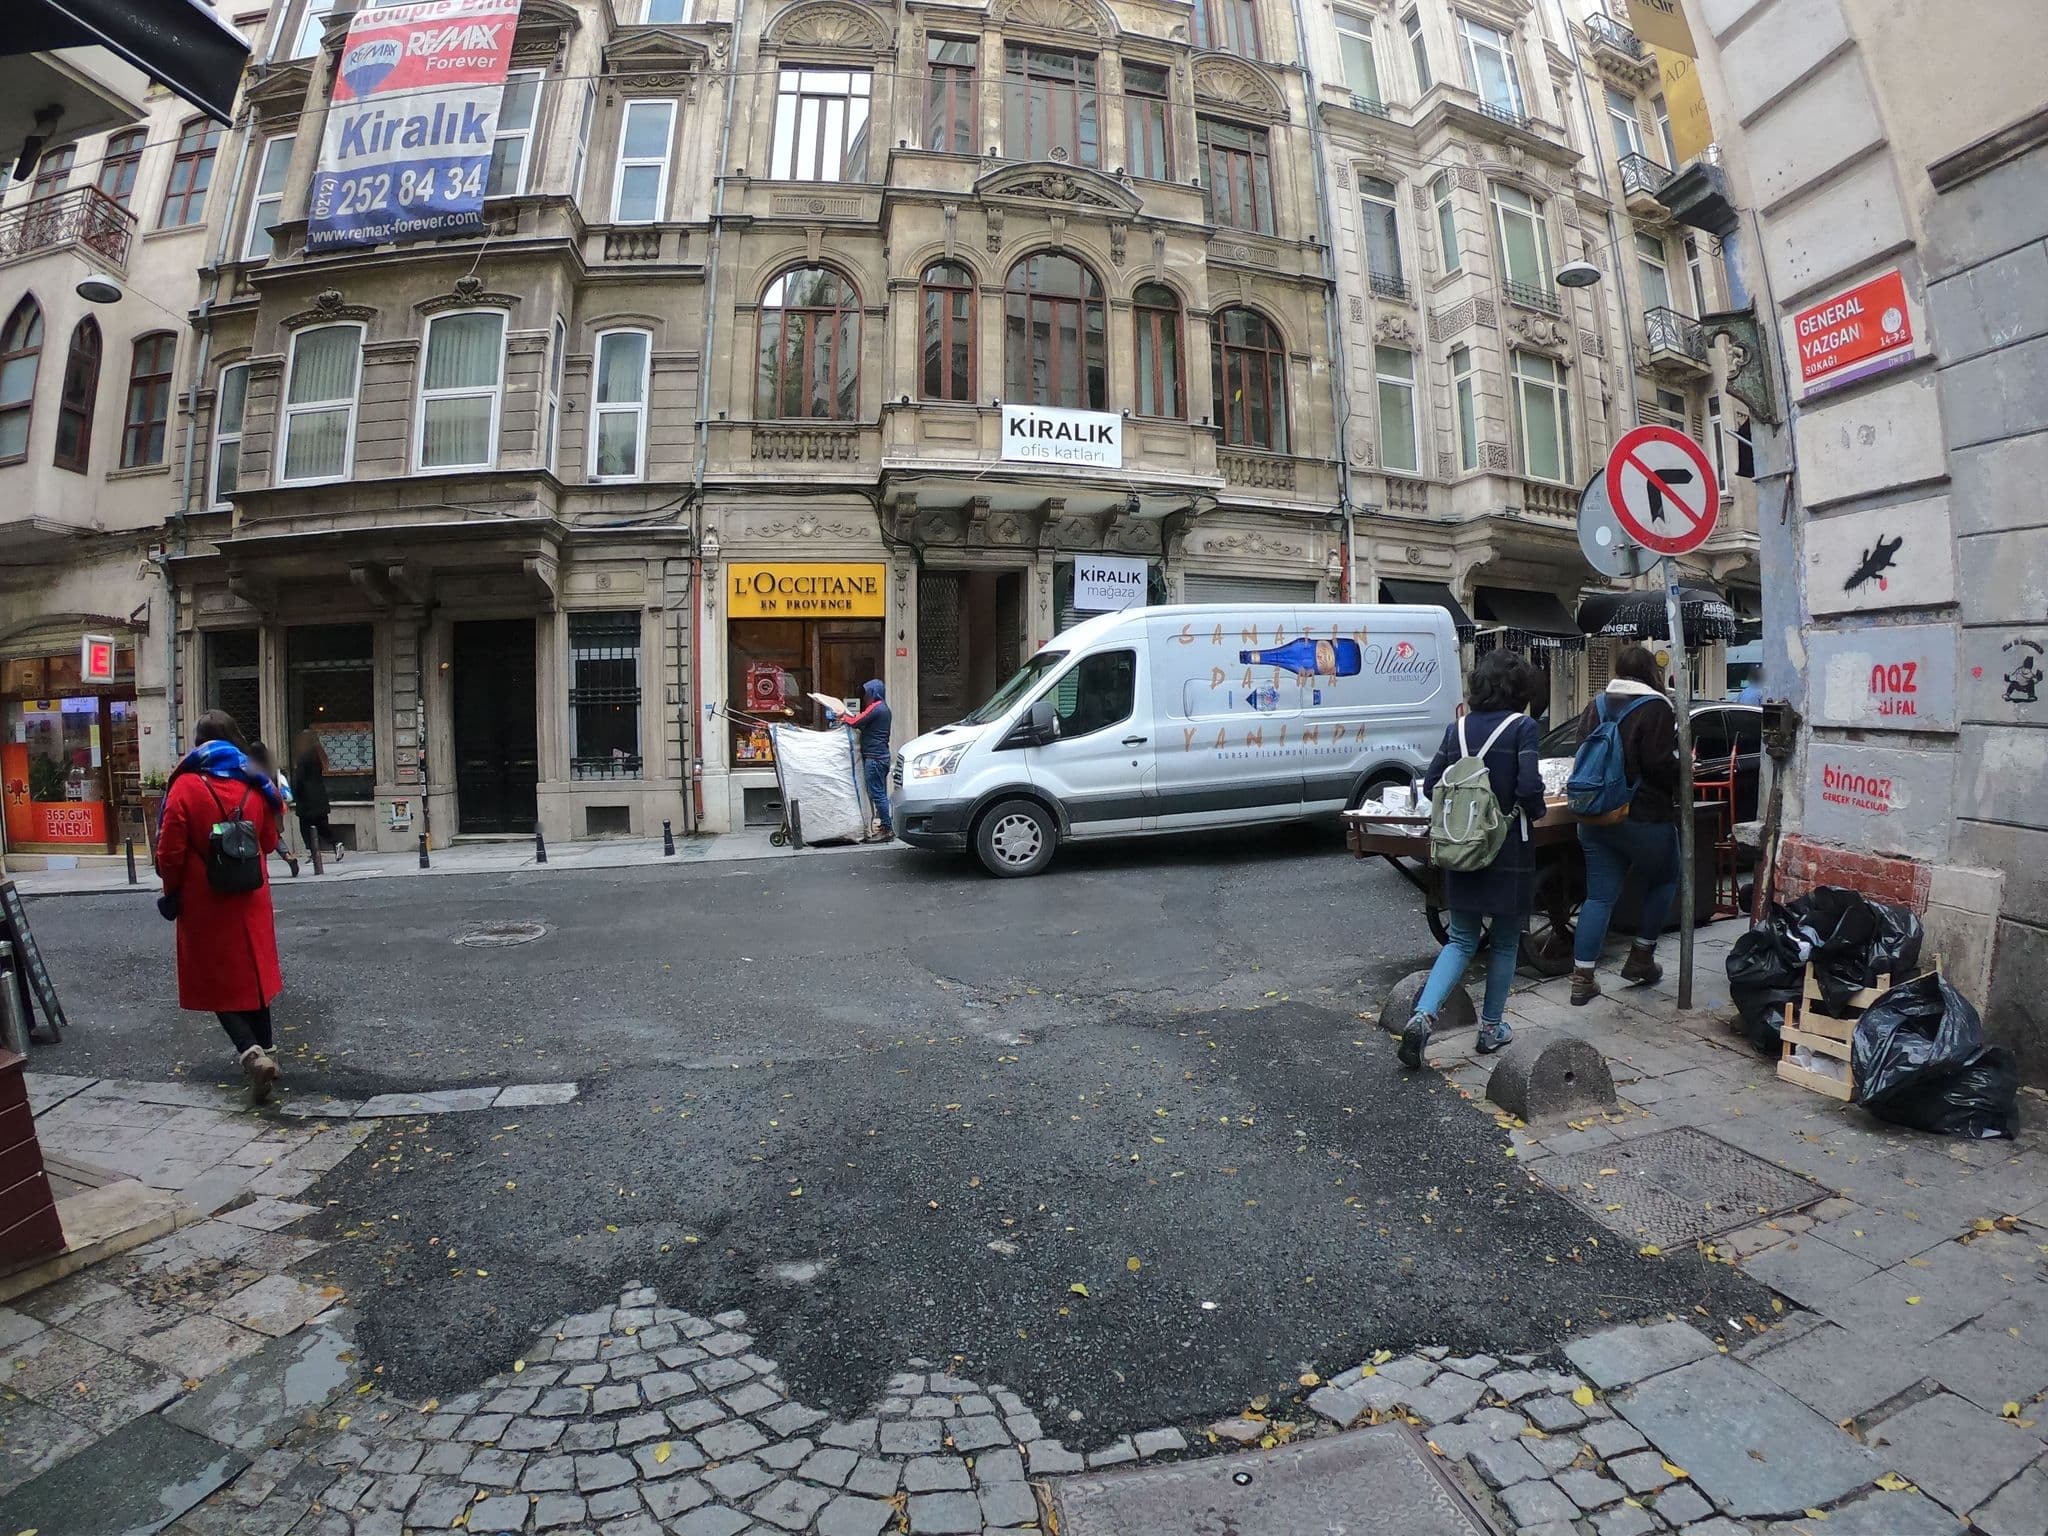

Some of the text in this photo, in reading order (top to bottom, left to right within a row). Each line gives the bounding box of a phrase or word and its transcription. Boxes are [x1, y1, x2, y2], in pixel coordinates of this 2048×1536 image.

[426, 56, 496, 71] Forever
[338, 102, 491, 160] Kiralık
[315, 164, 481, 220] (0212) 252 84 34
[313, 211, 478, 242] www.remax-forever.com
[1800, 297, 1864, 336] GENERAL
[1803, 323, 1860, 358] YAZGAN
[1805, 355, 1838, 375] SOKAĞI
[1010, 412, 1113, 444] KİRALIK
[1021, 445, 1104, 462] ofis katları
[735, 572, 877, 594] L'OCCITANE
[1081, 565, 1141, 584] KİRALIK
[761, 600, 852, 609] EN PROVENCE
[1087, 585, 1135, 599] mağaza
[93, 644, 110, 676] E
[1365, 644, 1439, 684] Uludağ
[1896, 700, 1916, 715] FAL
[1823, 764, 1892, 799] binnaz
[46, 808, 91, 821] 365 GÜN
